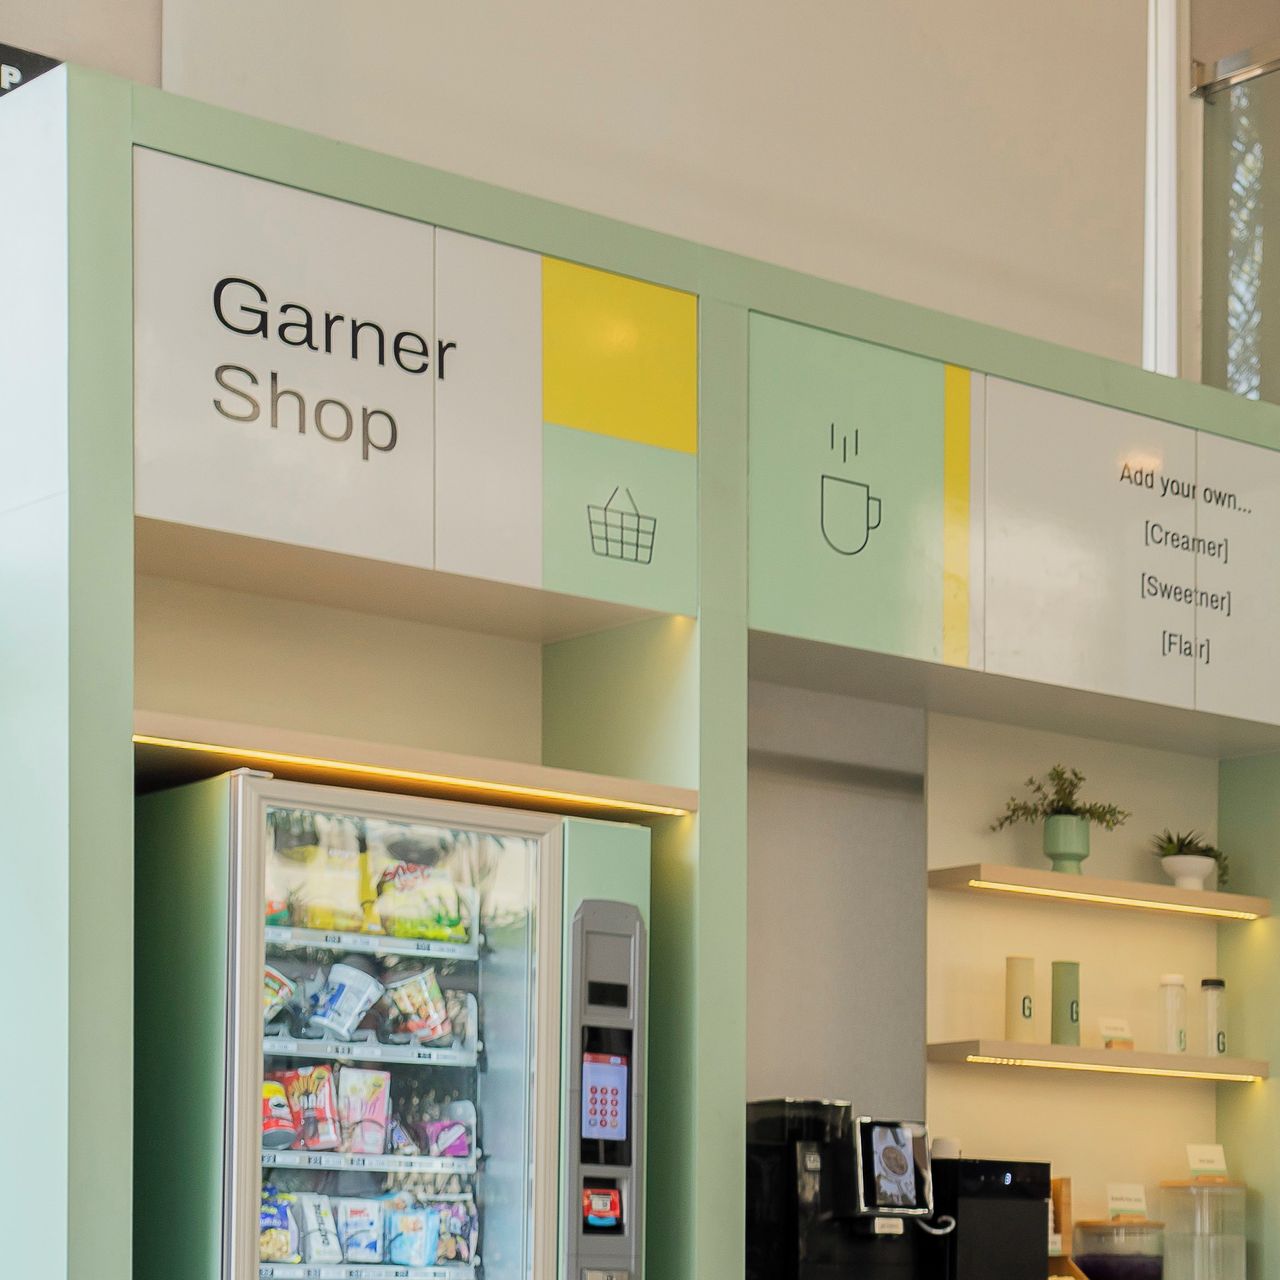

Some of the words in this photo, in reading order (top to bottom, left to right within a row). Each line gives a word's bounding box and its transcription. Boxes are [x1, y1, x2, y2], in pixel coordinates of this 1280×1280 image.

[213, 277, 457, 380] Garner
[213, 364, 398, 461] Shop
[1120, 463, 1154, 489] Add
[1160, 474, 1197, 499] your
[1203, 486, 1252, 514] own...
[1144, 519, 1229, 565] [Creamer]
[1141, 571, 1231, 617] [Sweetner]
[1022, 995, 1032, 1019] G
[1070, 1000, 1079, 1024] G
[1216, 1030, 1226, 1053] G
